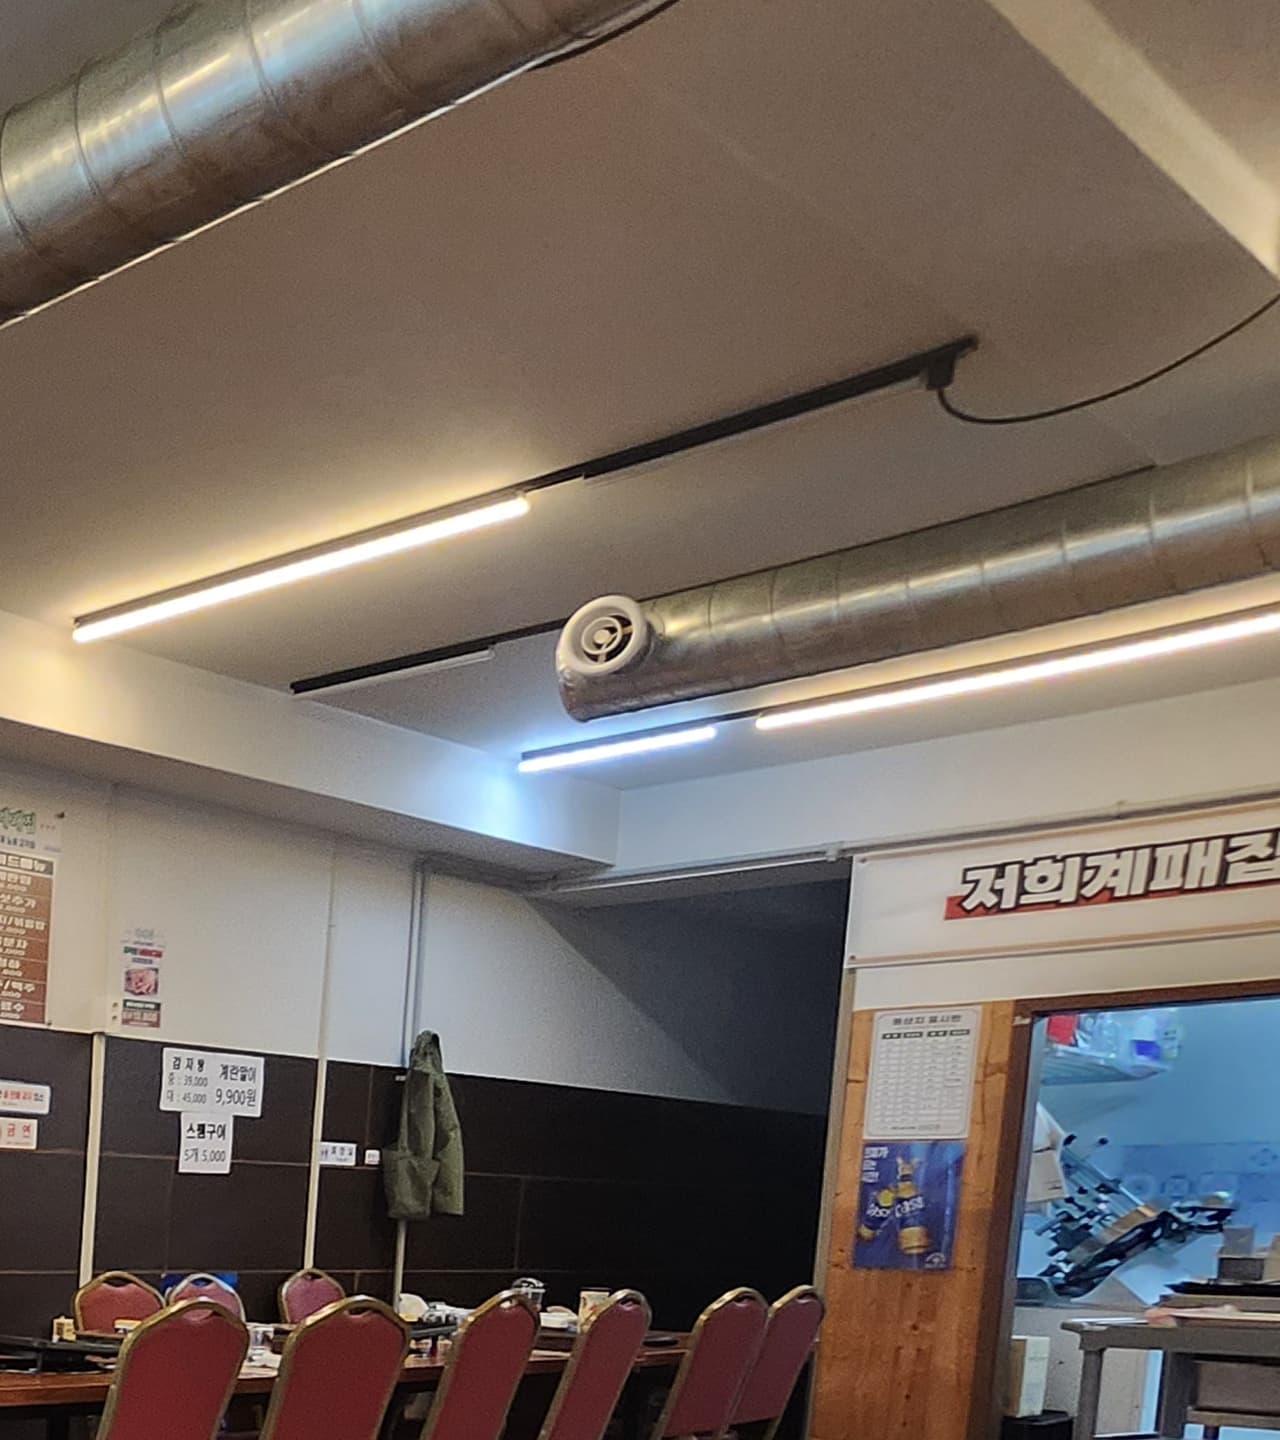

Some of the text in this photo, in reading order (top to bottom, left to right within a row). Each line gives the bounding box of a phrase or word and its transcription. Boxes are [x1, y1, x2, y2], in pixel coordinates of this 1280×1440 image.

[219, 1063, 257, 1083] 계란말이
[215, 1088, 256, 1107] 9,900원
[186, 1123, 226, 1141] 스팸구이
